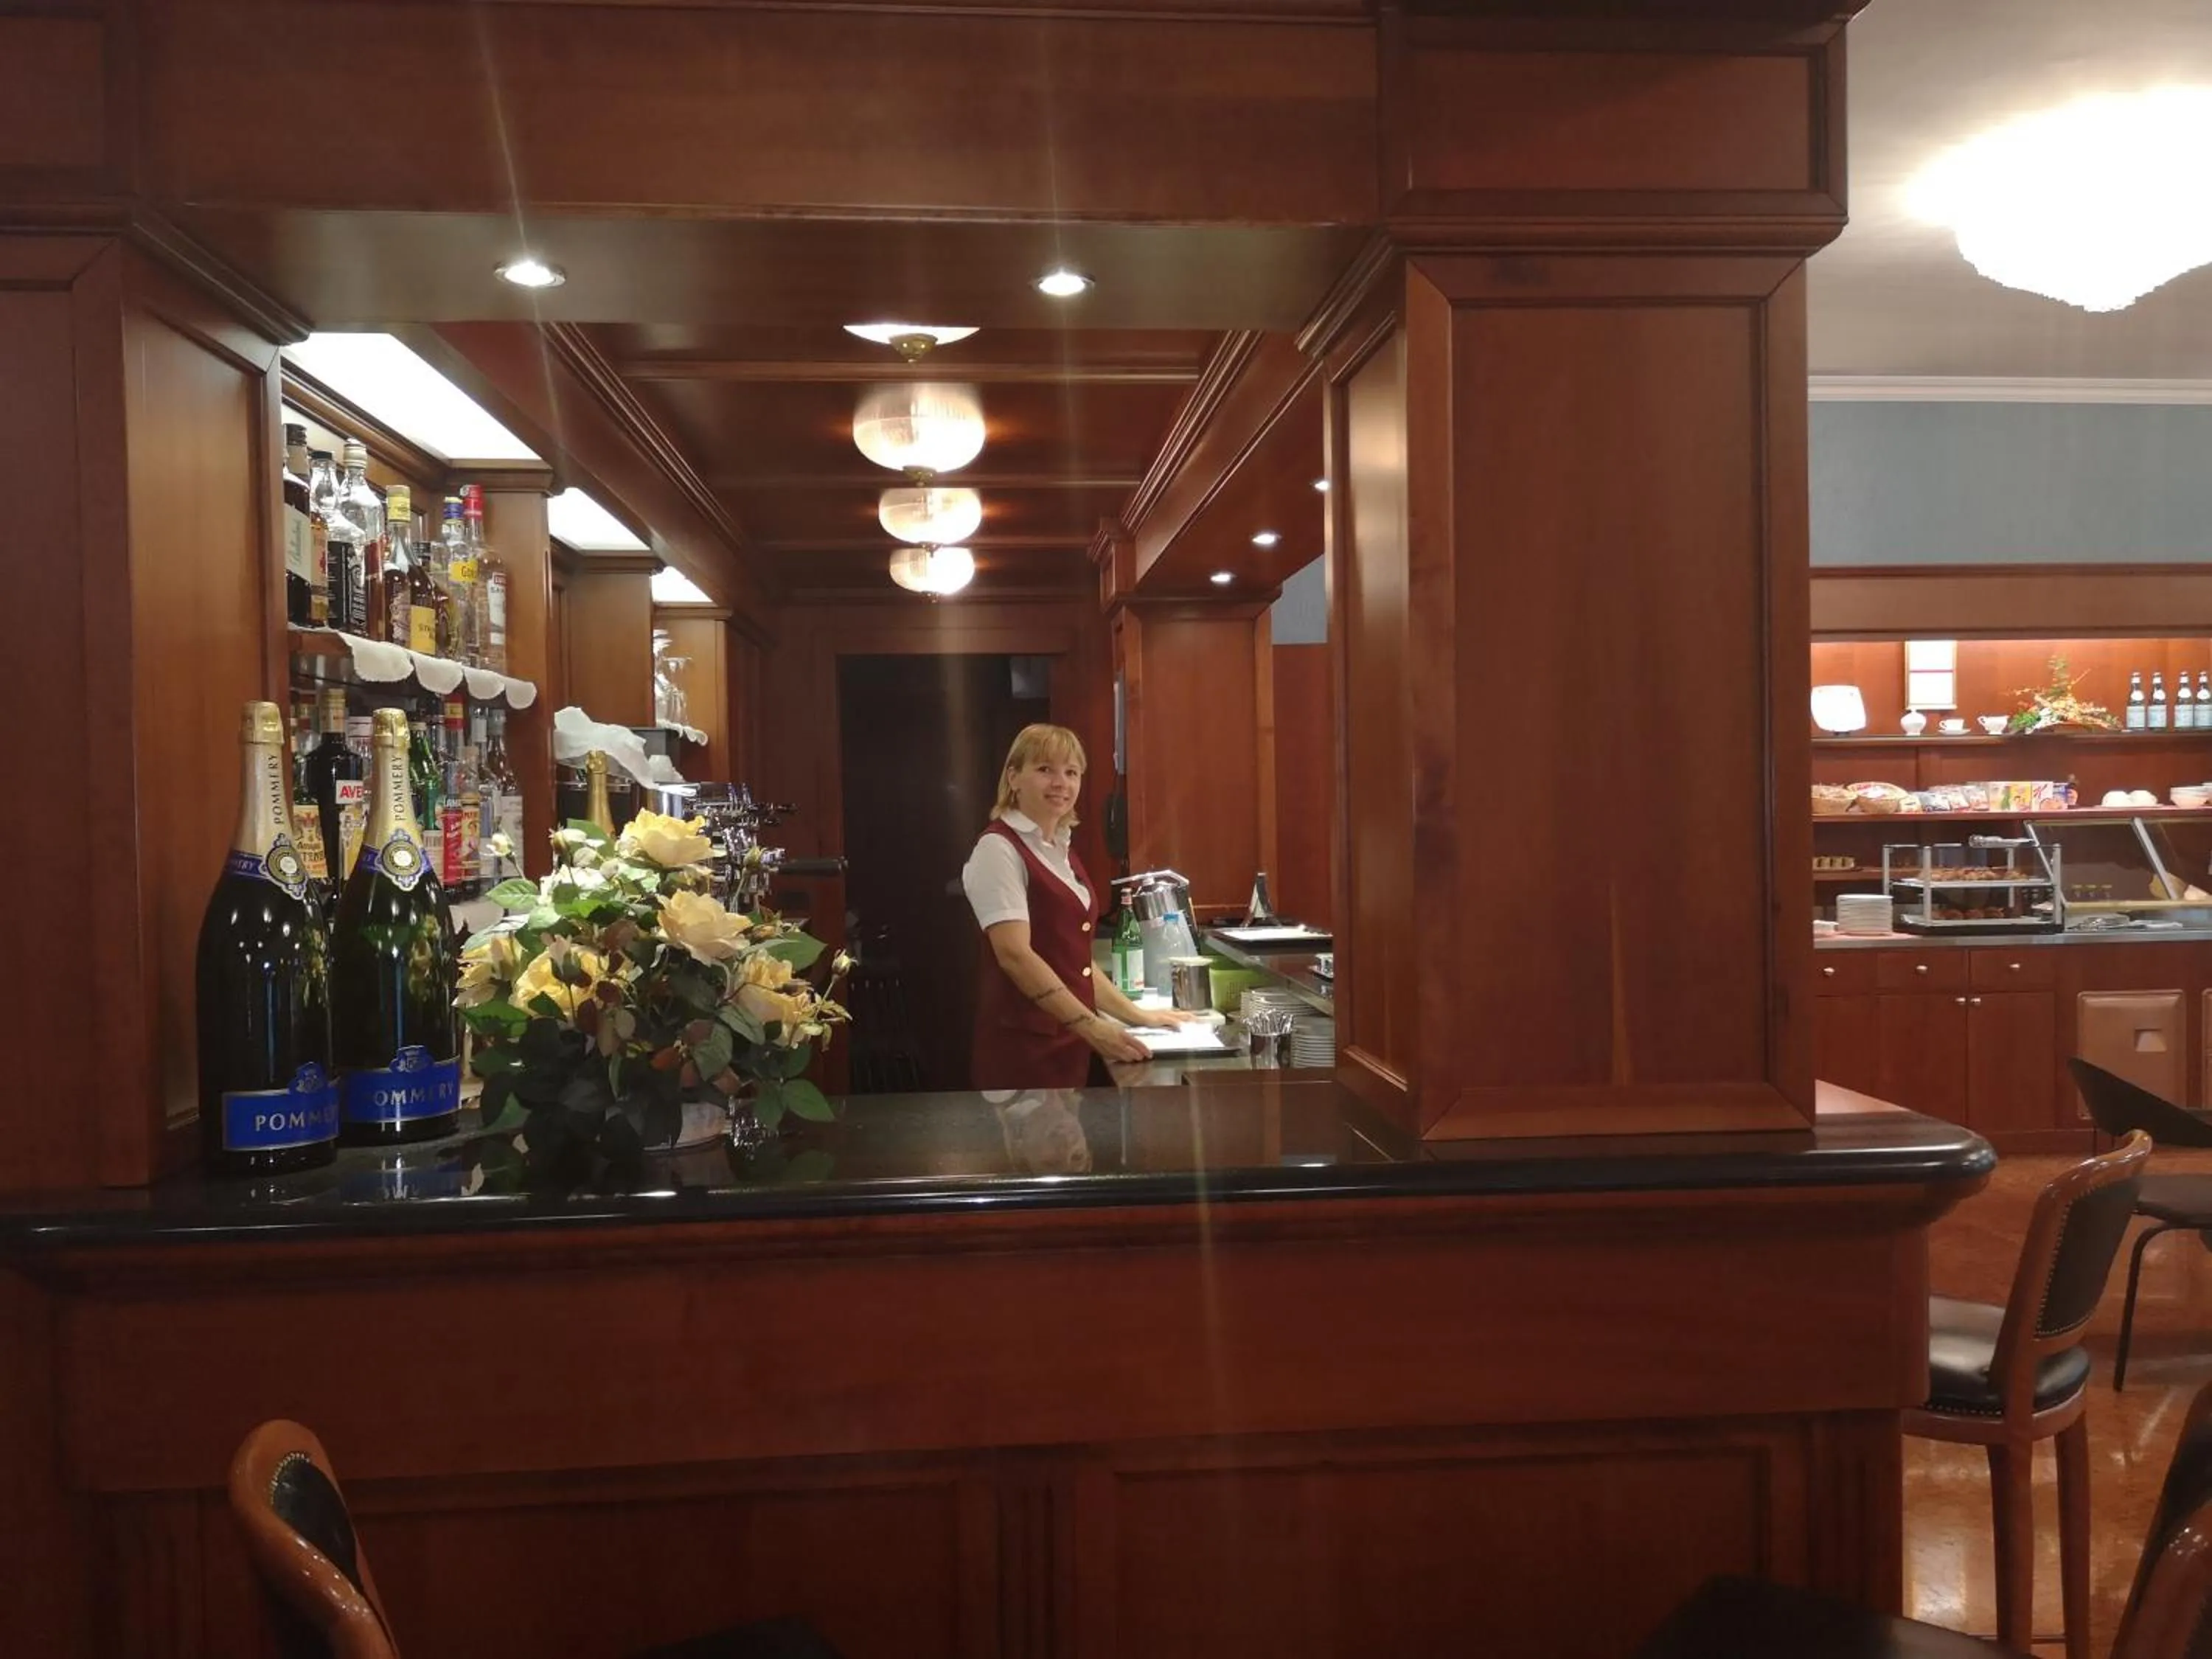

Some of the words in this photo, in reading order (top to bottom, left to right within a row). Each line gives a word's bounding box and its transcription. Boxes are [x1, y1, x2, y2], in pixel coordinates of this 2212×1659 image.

[267, 754, 285, 824] POMMERY
[339, 785, 364, 799] AVE
[391, 755, 406, 821] POMMERY
[375, 1079, 454, 1107] OMMRY
[254, 1105, 336, 1132] POMME
